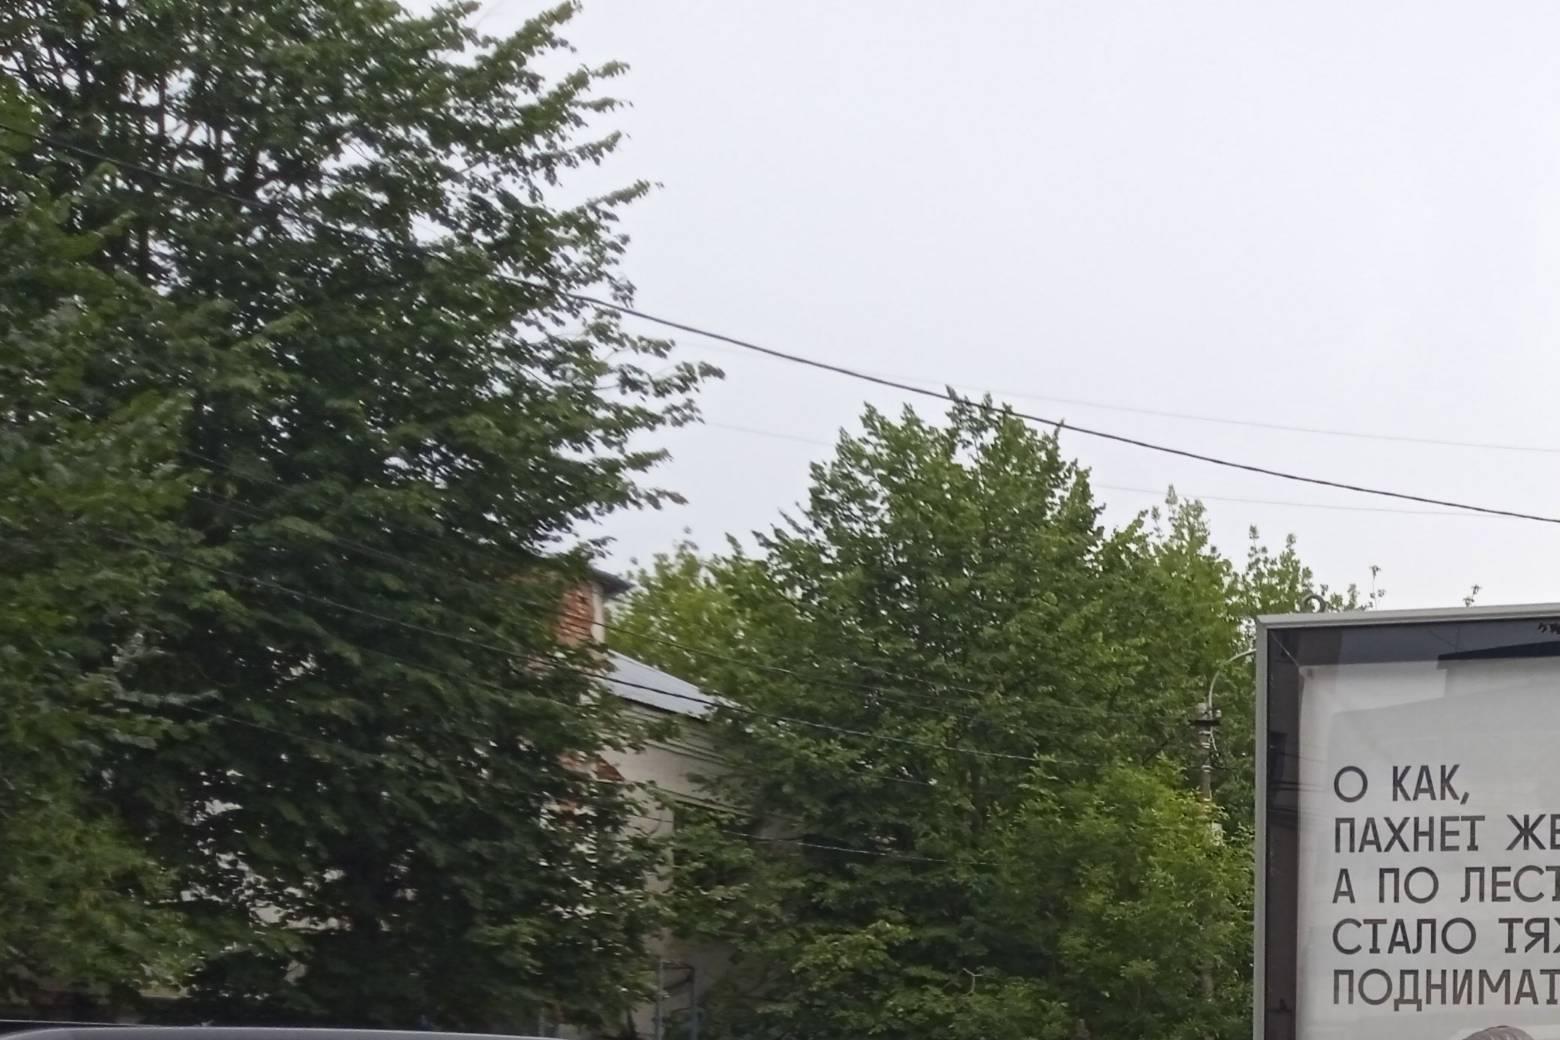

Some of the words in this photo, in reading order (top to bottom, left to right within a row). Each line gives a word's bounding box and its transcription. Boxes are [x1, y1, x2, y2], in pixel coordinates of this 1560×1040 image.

[1332, 764, 1369, 803] О
[1391, 763, 1471, 804] КАК,
[1333, 814, 1487, 854] ПАХНЕТ
[1332, 866, 1357, 905] А
[1377, 866, 1439, 905] ПО
[1331, 917, 1478, 956] СТАЛО
